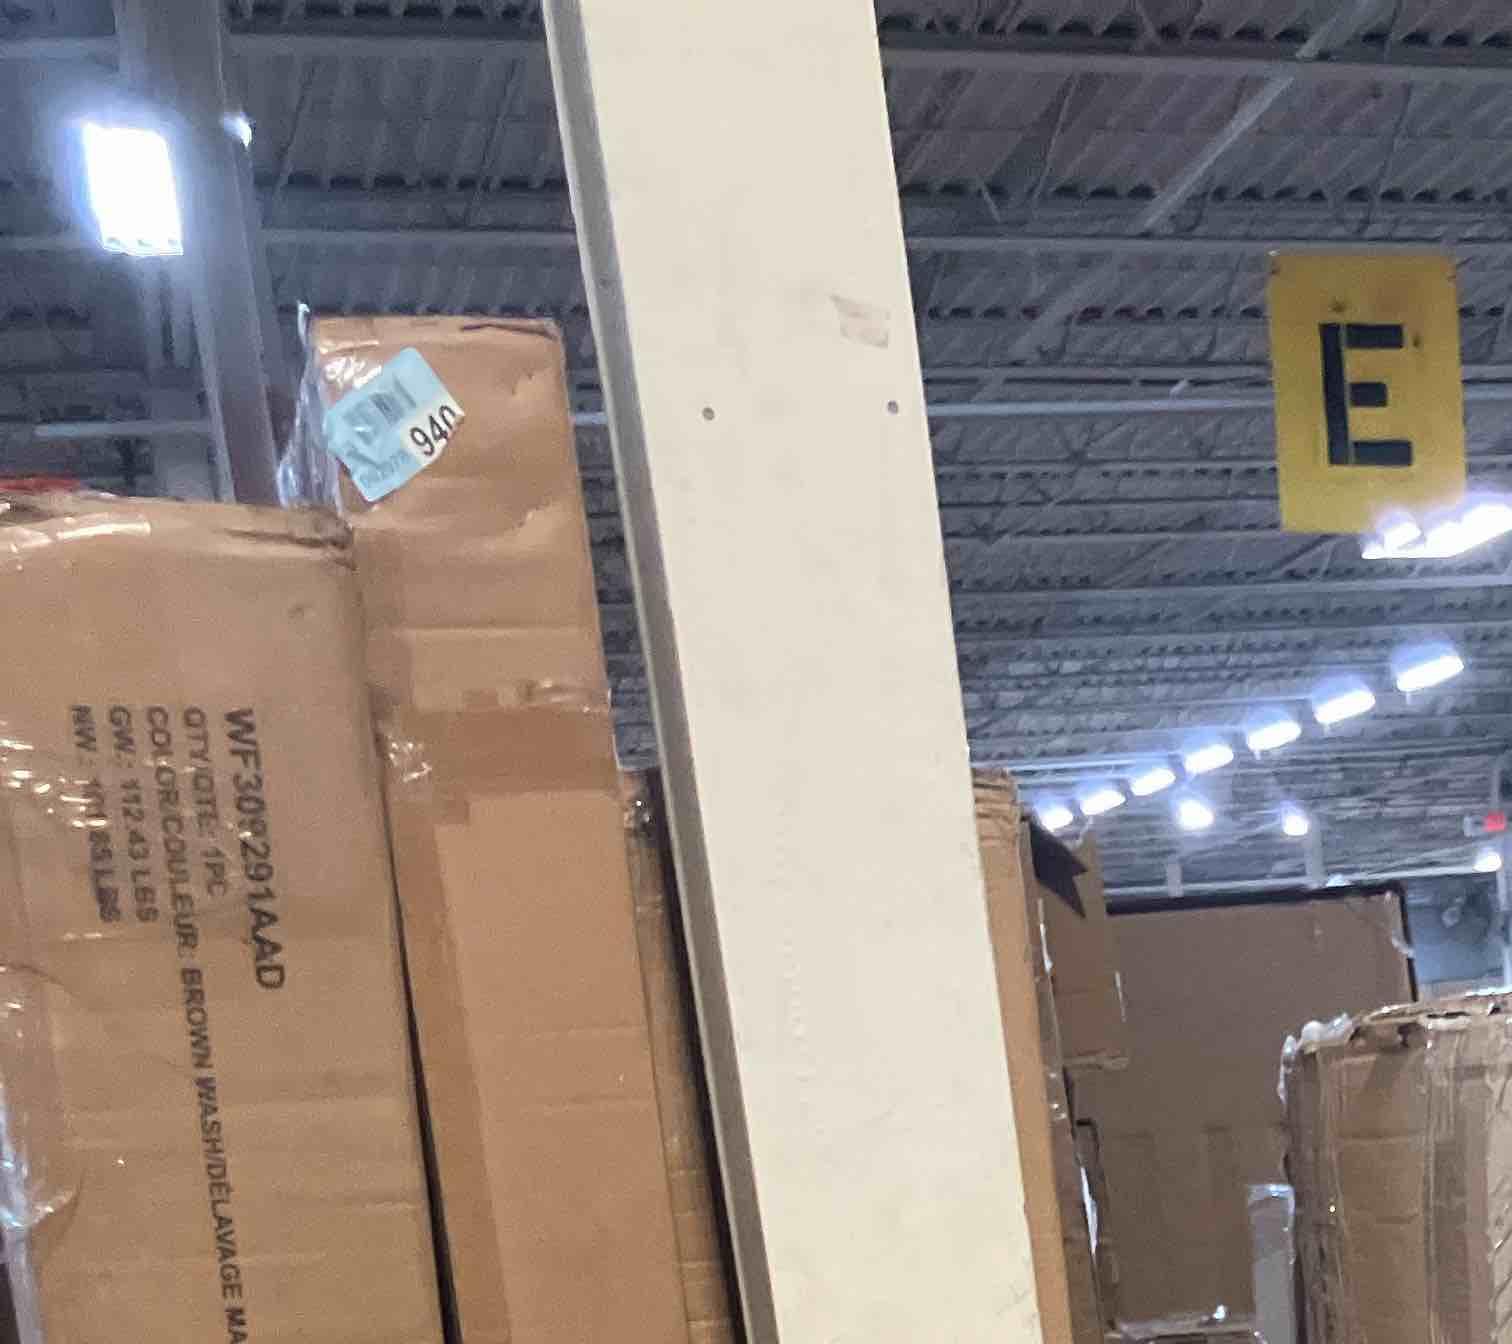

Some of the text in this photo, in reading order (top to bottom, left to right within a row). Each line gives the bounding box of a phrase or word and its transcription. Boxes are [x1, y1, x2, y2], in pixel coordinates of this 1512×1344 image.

[1318, 322, 1412, 466] E
[131, 868, 160, 922] LBS
[203, 846, 227, 897] 1PC
[179, 967, 214, 1078] BROWN
[198, 1075, 243, 1299] WASH/DÉLAVAGE
